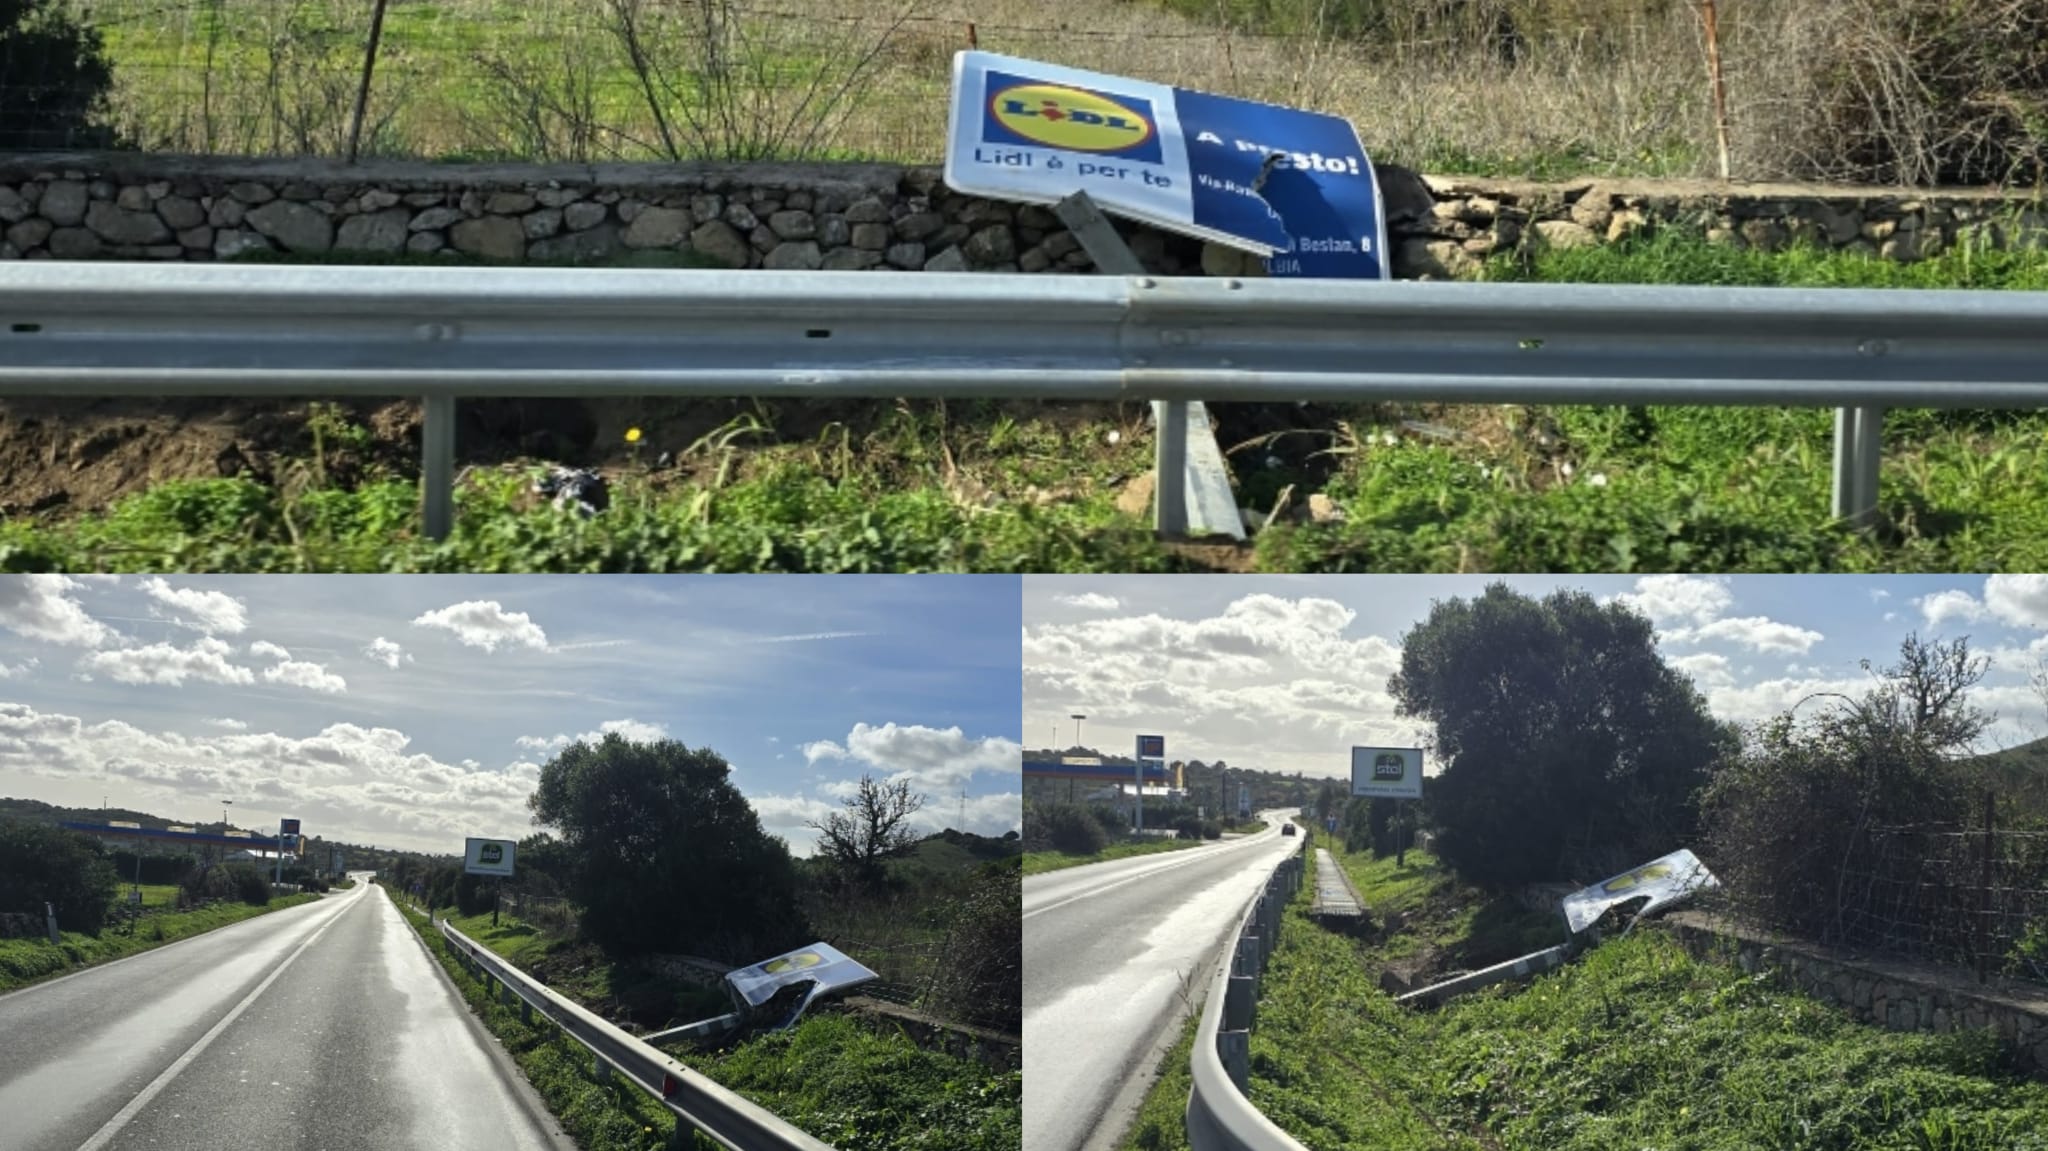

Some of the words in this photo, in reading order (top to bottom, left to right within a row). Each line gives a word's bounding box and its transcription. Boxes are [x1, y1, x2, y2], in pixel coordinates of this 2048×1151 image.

[1197, 131, 1224, 145] A
[975, 148, 1032, 166] Lidl
[1047, 155, 1064, 169] è
[1078, 162, 1130, 179] per
[1141, 169, 1172, 188] te
